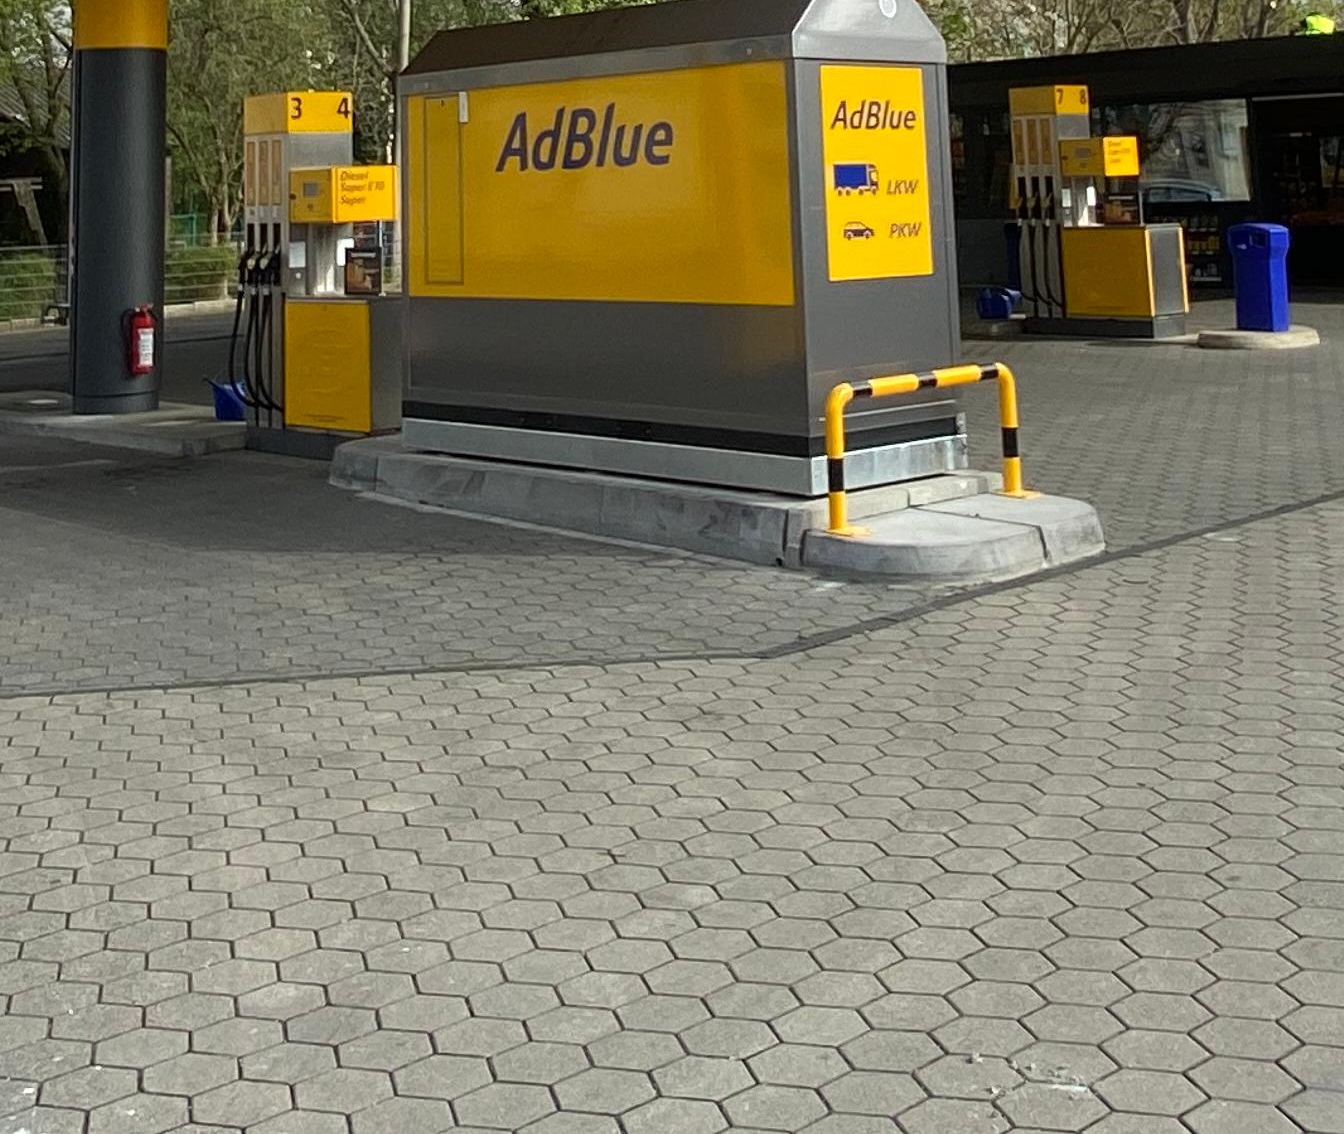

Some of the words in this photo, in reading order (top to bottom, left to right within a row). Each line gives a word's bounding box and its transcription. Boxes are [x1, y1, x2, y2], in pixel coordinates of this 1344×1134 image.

[290, 97, 303, 119] 3
[337, 97, 351, 119] 4
[830, 100, 916, 130] AdBlue
[495, 102, 675, 173] AdBlue
[886, 179, 919, 196] LKW
[889, 222, 922, 239] PKW
